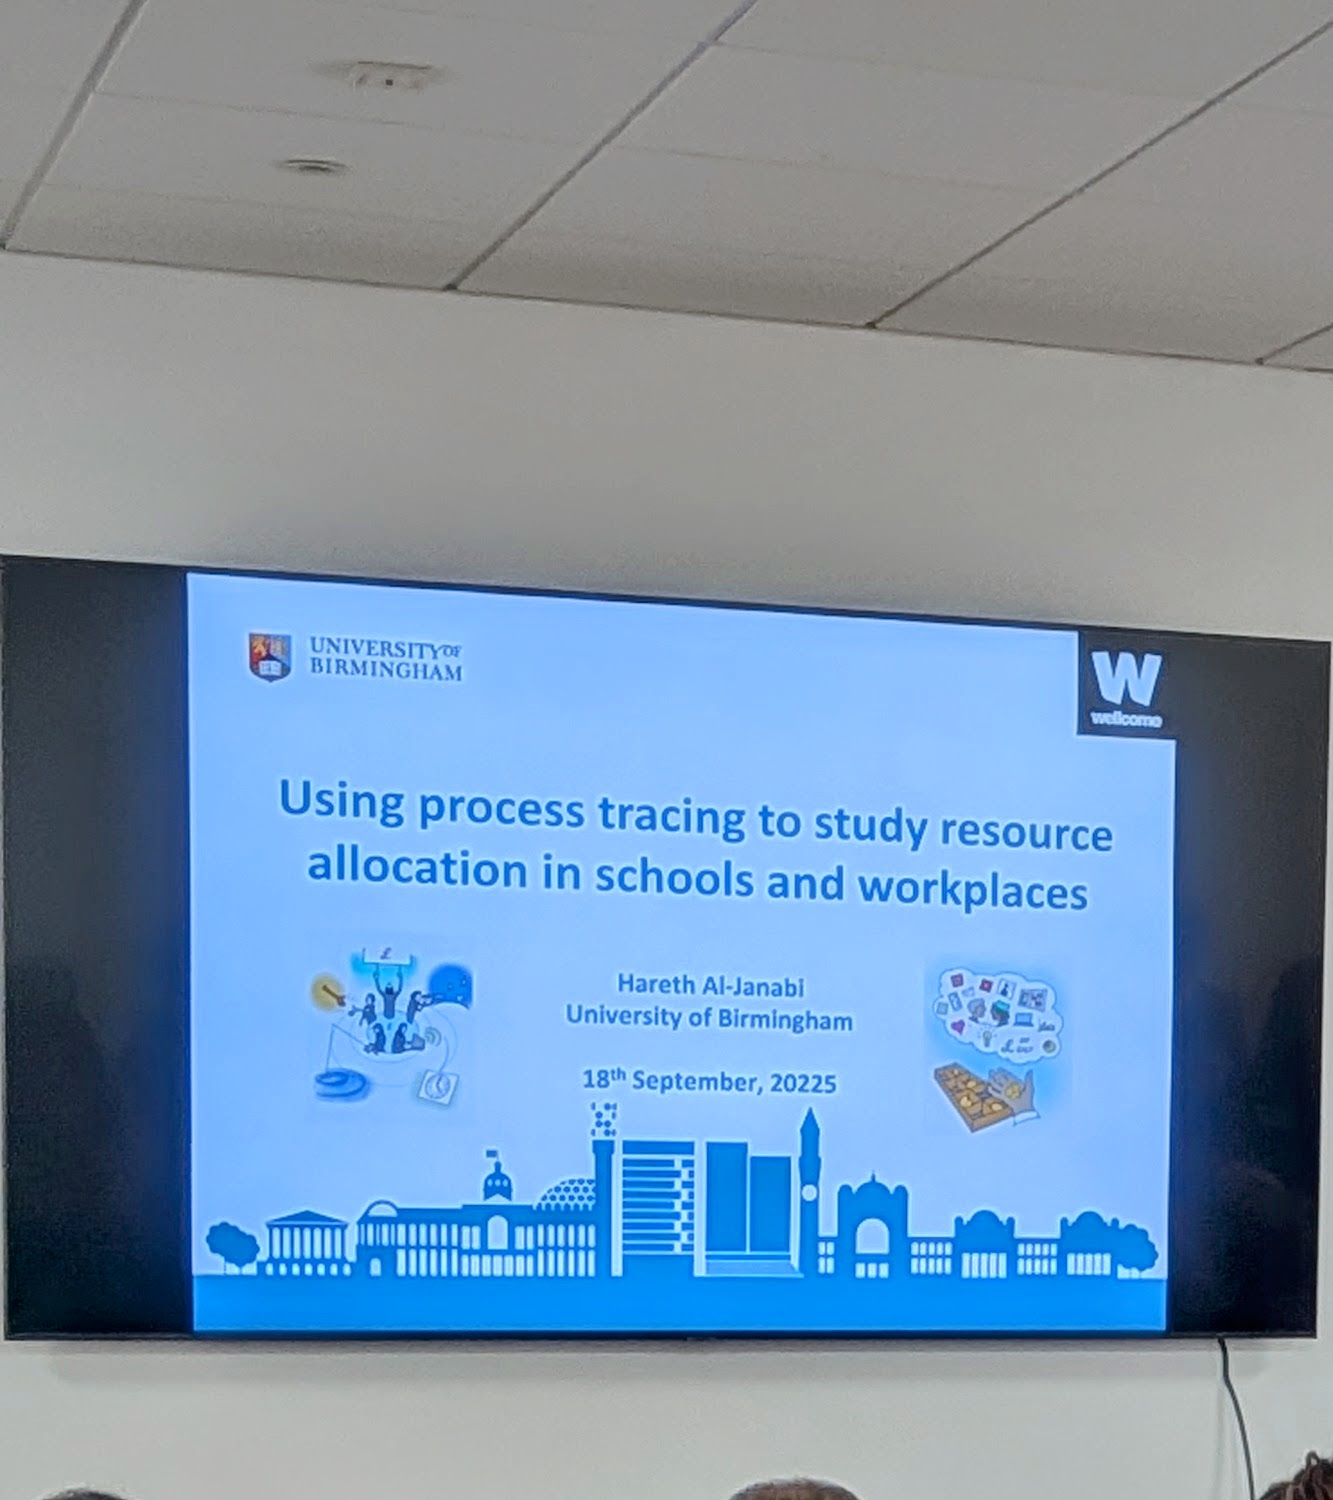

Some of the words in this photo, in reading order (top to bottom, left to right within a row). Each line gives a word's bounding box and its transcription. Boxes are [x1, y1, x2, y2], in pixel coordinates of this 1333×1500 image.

[309, 635, 439, 660] UNIVERSITY
[309, 656, 463, 682] BIRMINGHAM
[1091, 651, 1163, 707] W
[280, 778, 405, 828] Using
[419, 793, 586, 830] process
[600, 796, 746, 844] tracing
[758, 804, 802, 838] to
[814, 806, 928, 852] study
[940, 816, 1113, 853] resource
[307, 843, 527, 890] allocation
[543, 852, 582, 891] in
[595, 855, 754, 898] schools
[766, 864, 844, 902] and
[857, 869, 1089, 915] workplaces
[617, 973, 695, 996] Hareth
[702, 975, 805, 999] Al-Janabi
[566, 1004, 682, 1031] University
[688, 1006, 713, 1028] of
[718, 1008, 854, 1035] Birmingham
[632, 1069, 763, 1096] September,
[770, 1073, 837, 1095] 20225
